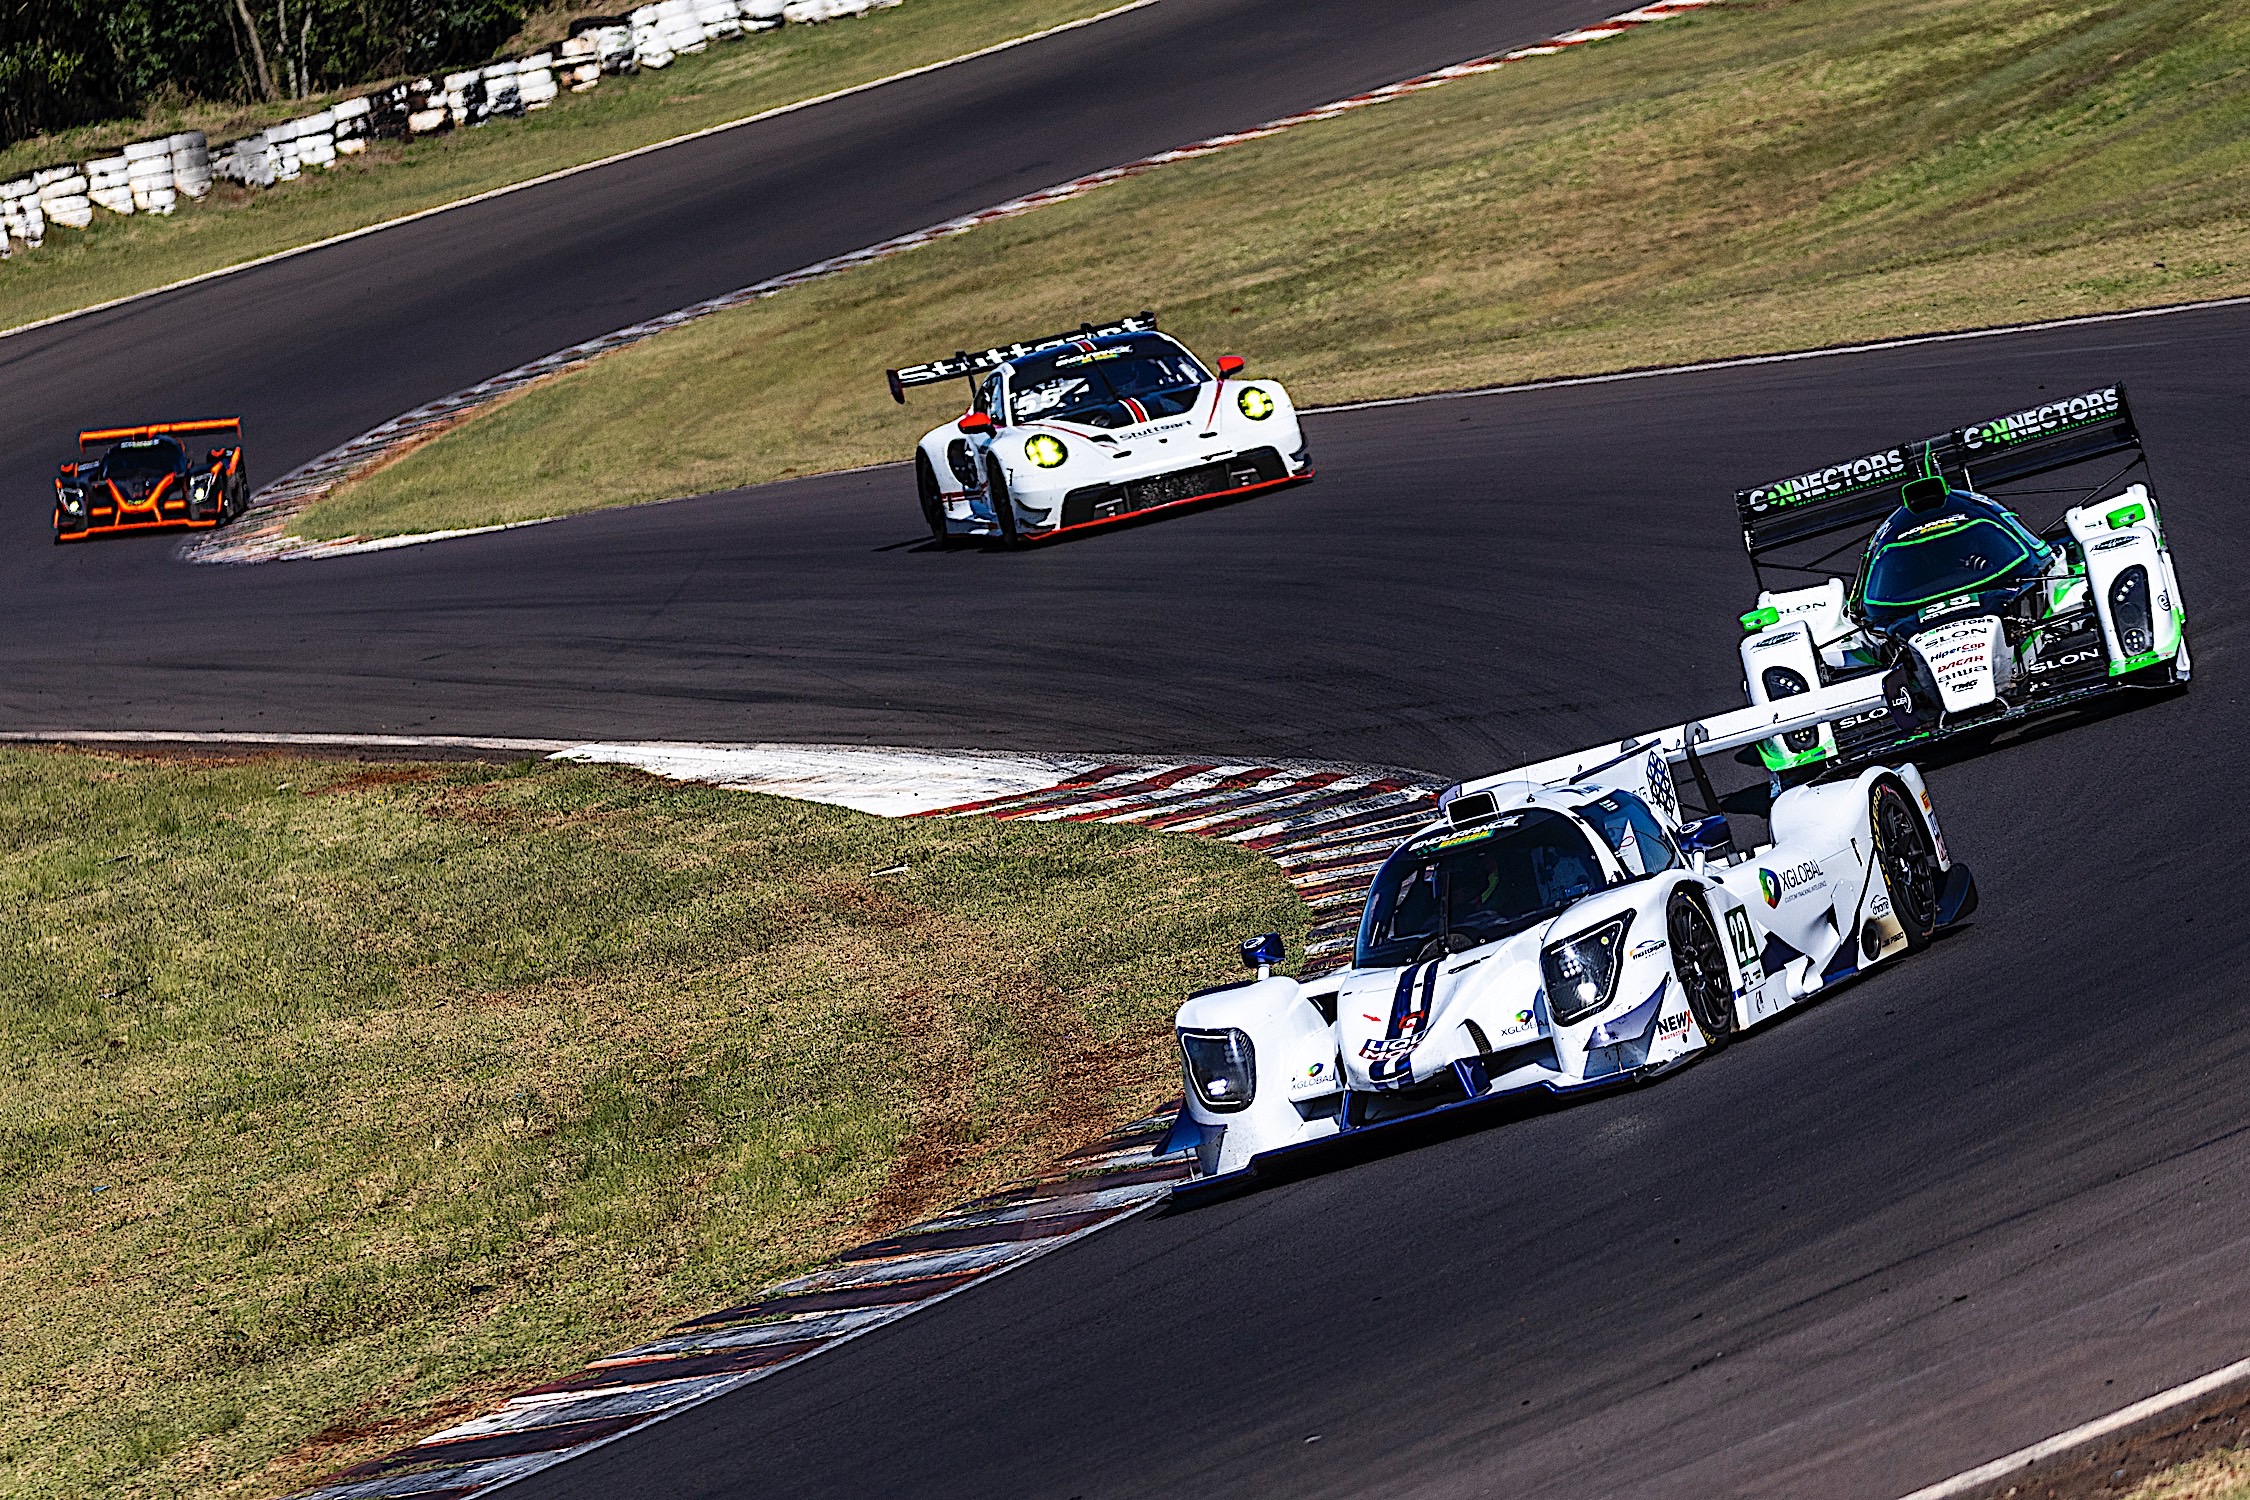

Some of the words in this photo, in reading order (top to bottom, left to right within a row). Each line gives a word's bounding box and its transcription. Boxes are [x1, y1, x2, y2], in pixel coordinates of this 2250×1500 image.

[1119, 419, 1193, 441] Stuttgart
[1964, 388, 2119, 449] CONNECTORS
[1750, 449, 1905, 512] CONNECTORS
[1914, 618, 1994, 644] CONNECTORS
[1925, 627, 1988, 650] SLON
[1937, 655, 1984, 674] DACAR
[2029, 647, 2100, 675] SLON
[1938, 665, 1988, 684] aiwa
[1839, 706, 1889, 730] SLO
[1408, 814, 1523, 852] ENDURANCE
[1779, 859, 1824, 892] XGLOBAL
[1729, 911, 1757, 964] 22
[1501, 1019, 1549, 1037] XGLOBAL
[1291, 1075, 1334, 1091] XGLOBAL
